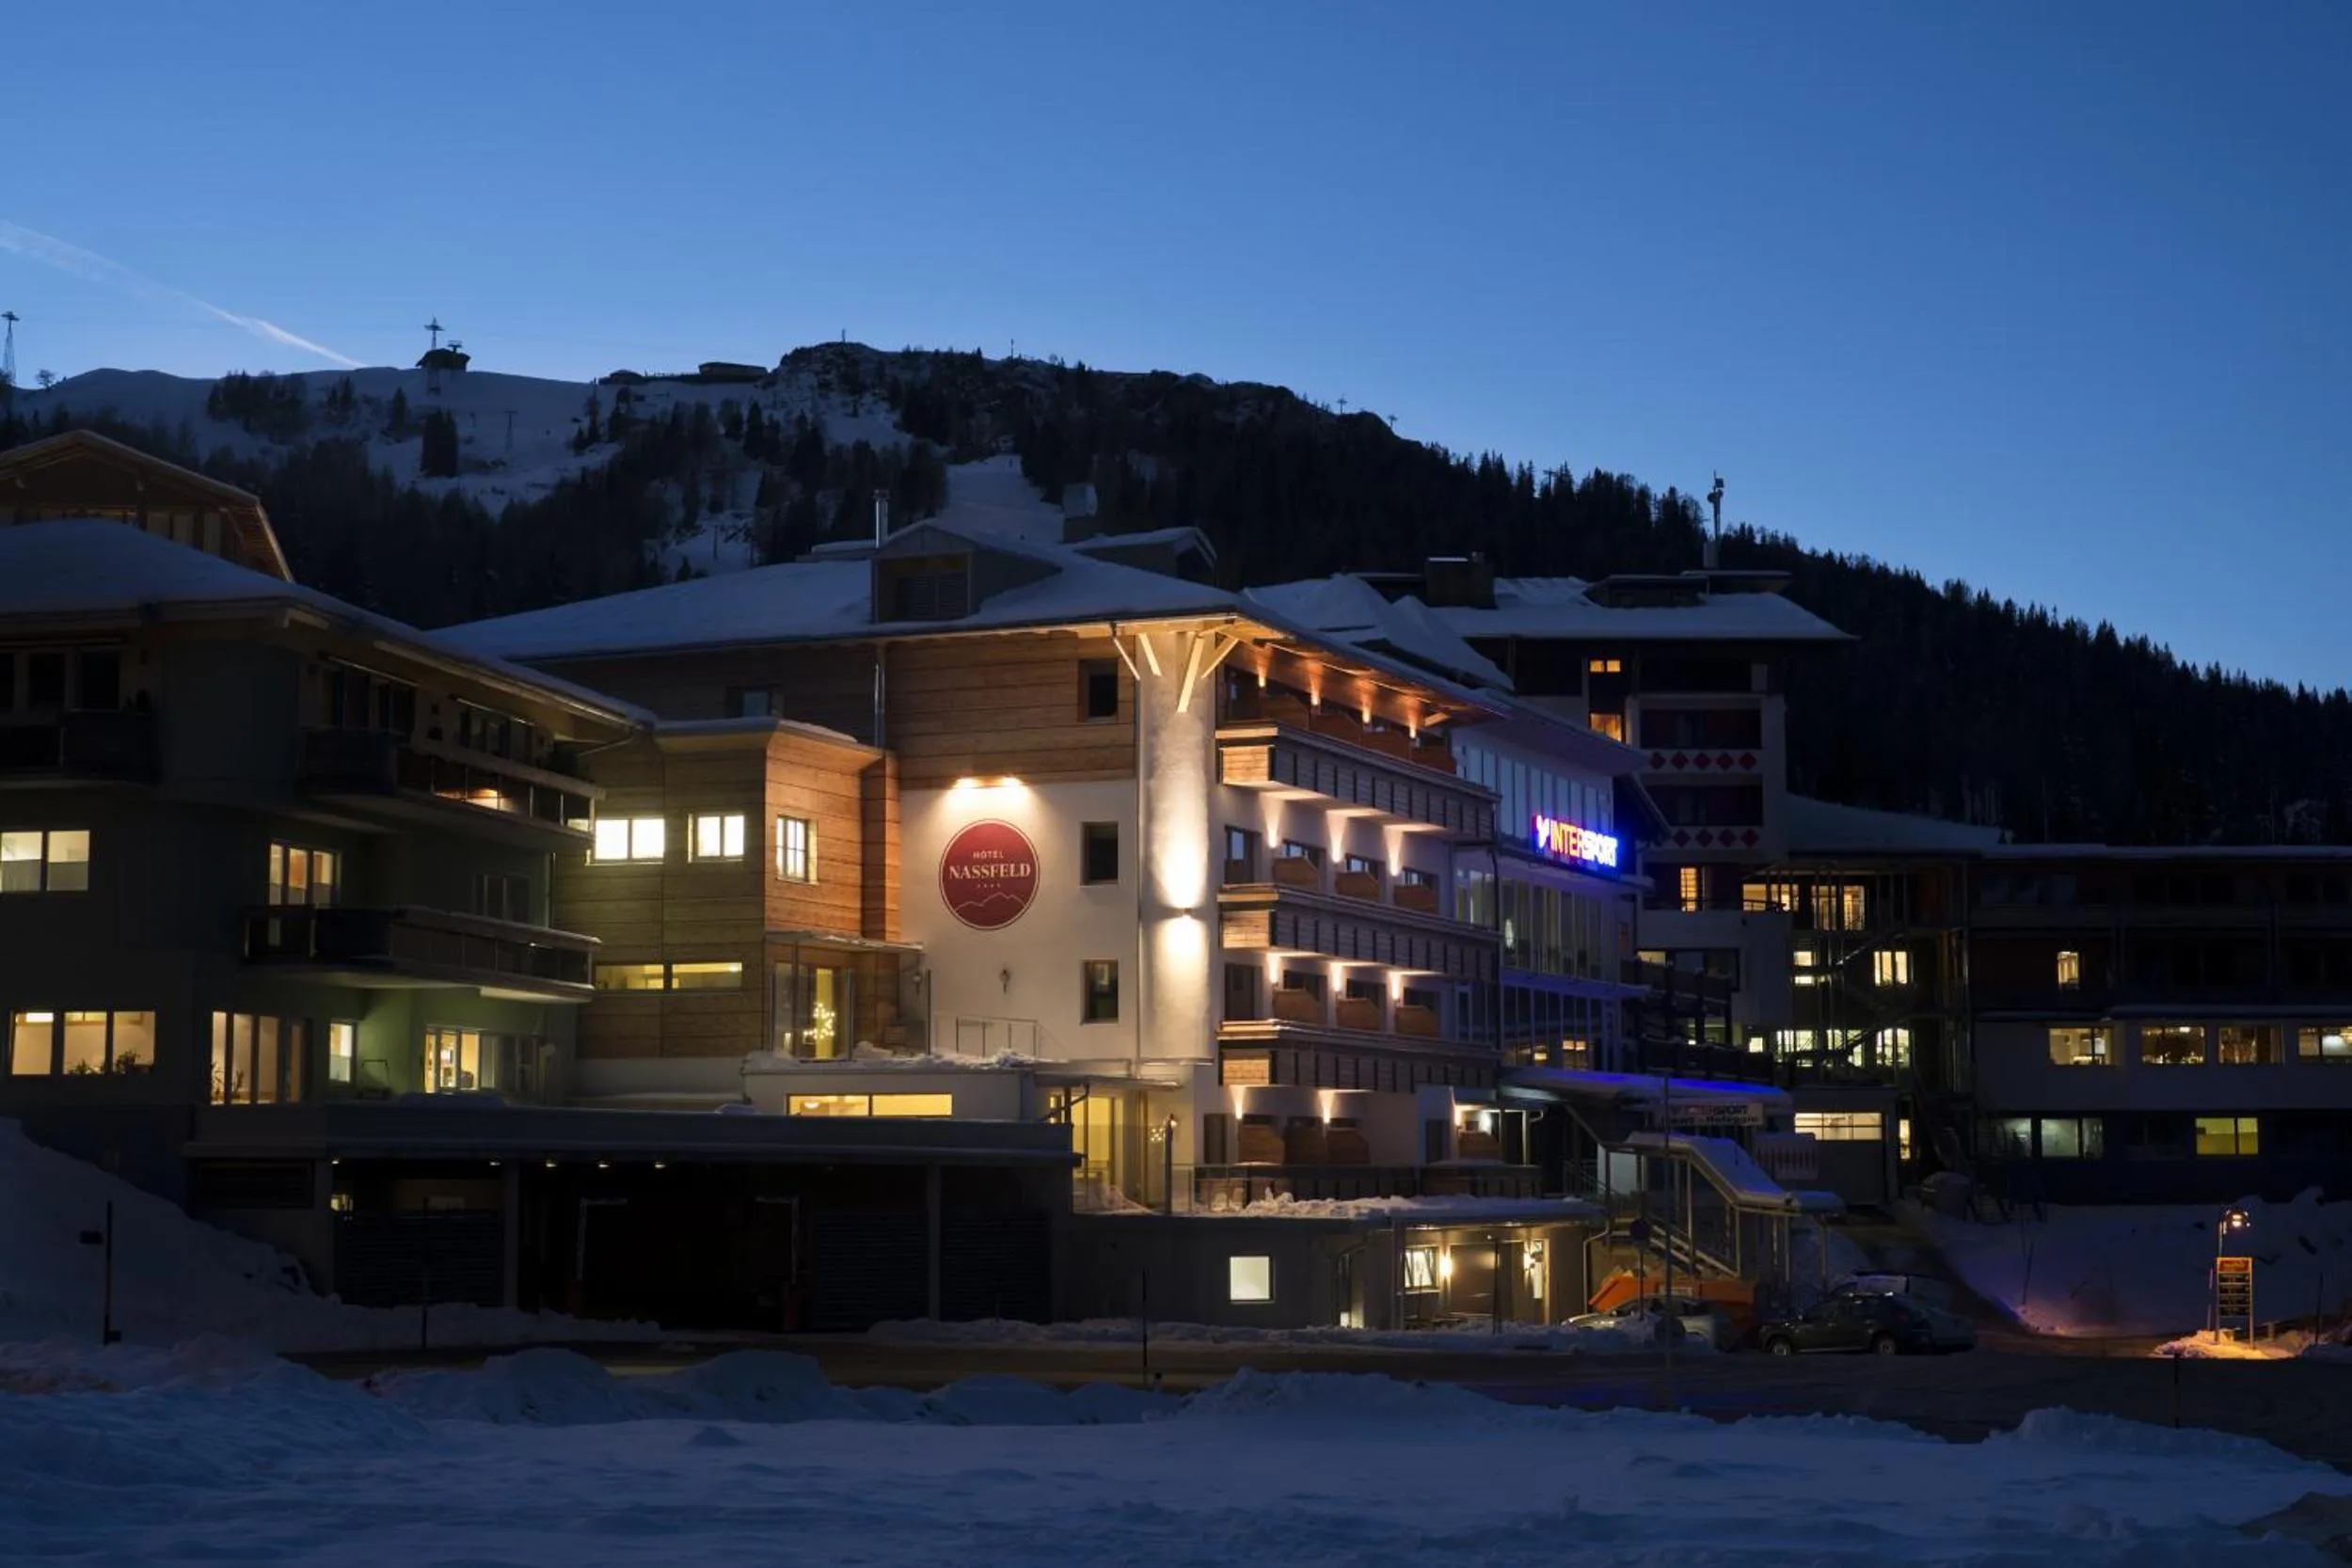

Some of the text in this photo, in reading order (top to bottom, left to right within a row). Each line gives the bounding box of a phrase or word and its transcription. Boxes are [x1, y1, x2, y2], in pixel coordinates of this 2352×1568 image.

[1550, 818, 1618, 867] INTERSPORT
[973, 850, 1004, 859] HOTEL
[948, 863, 1031, 879] NASSFELD
